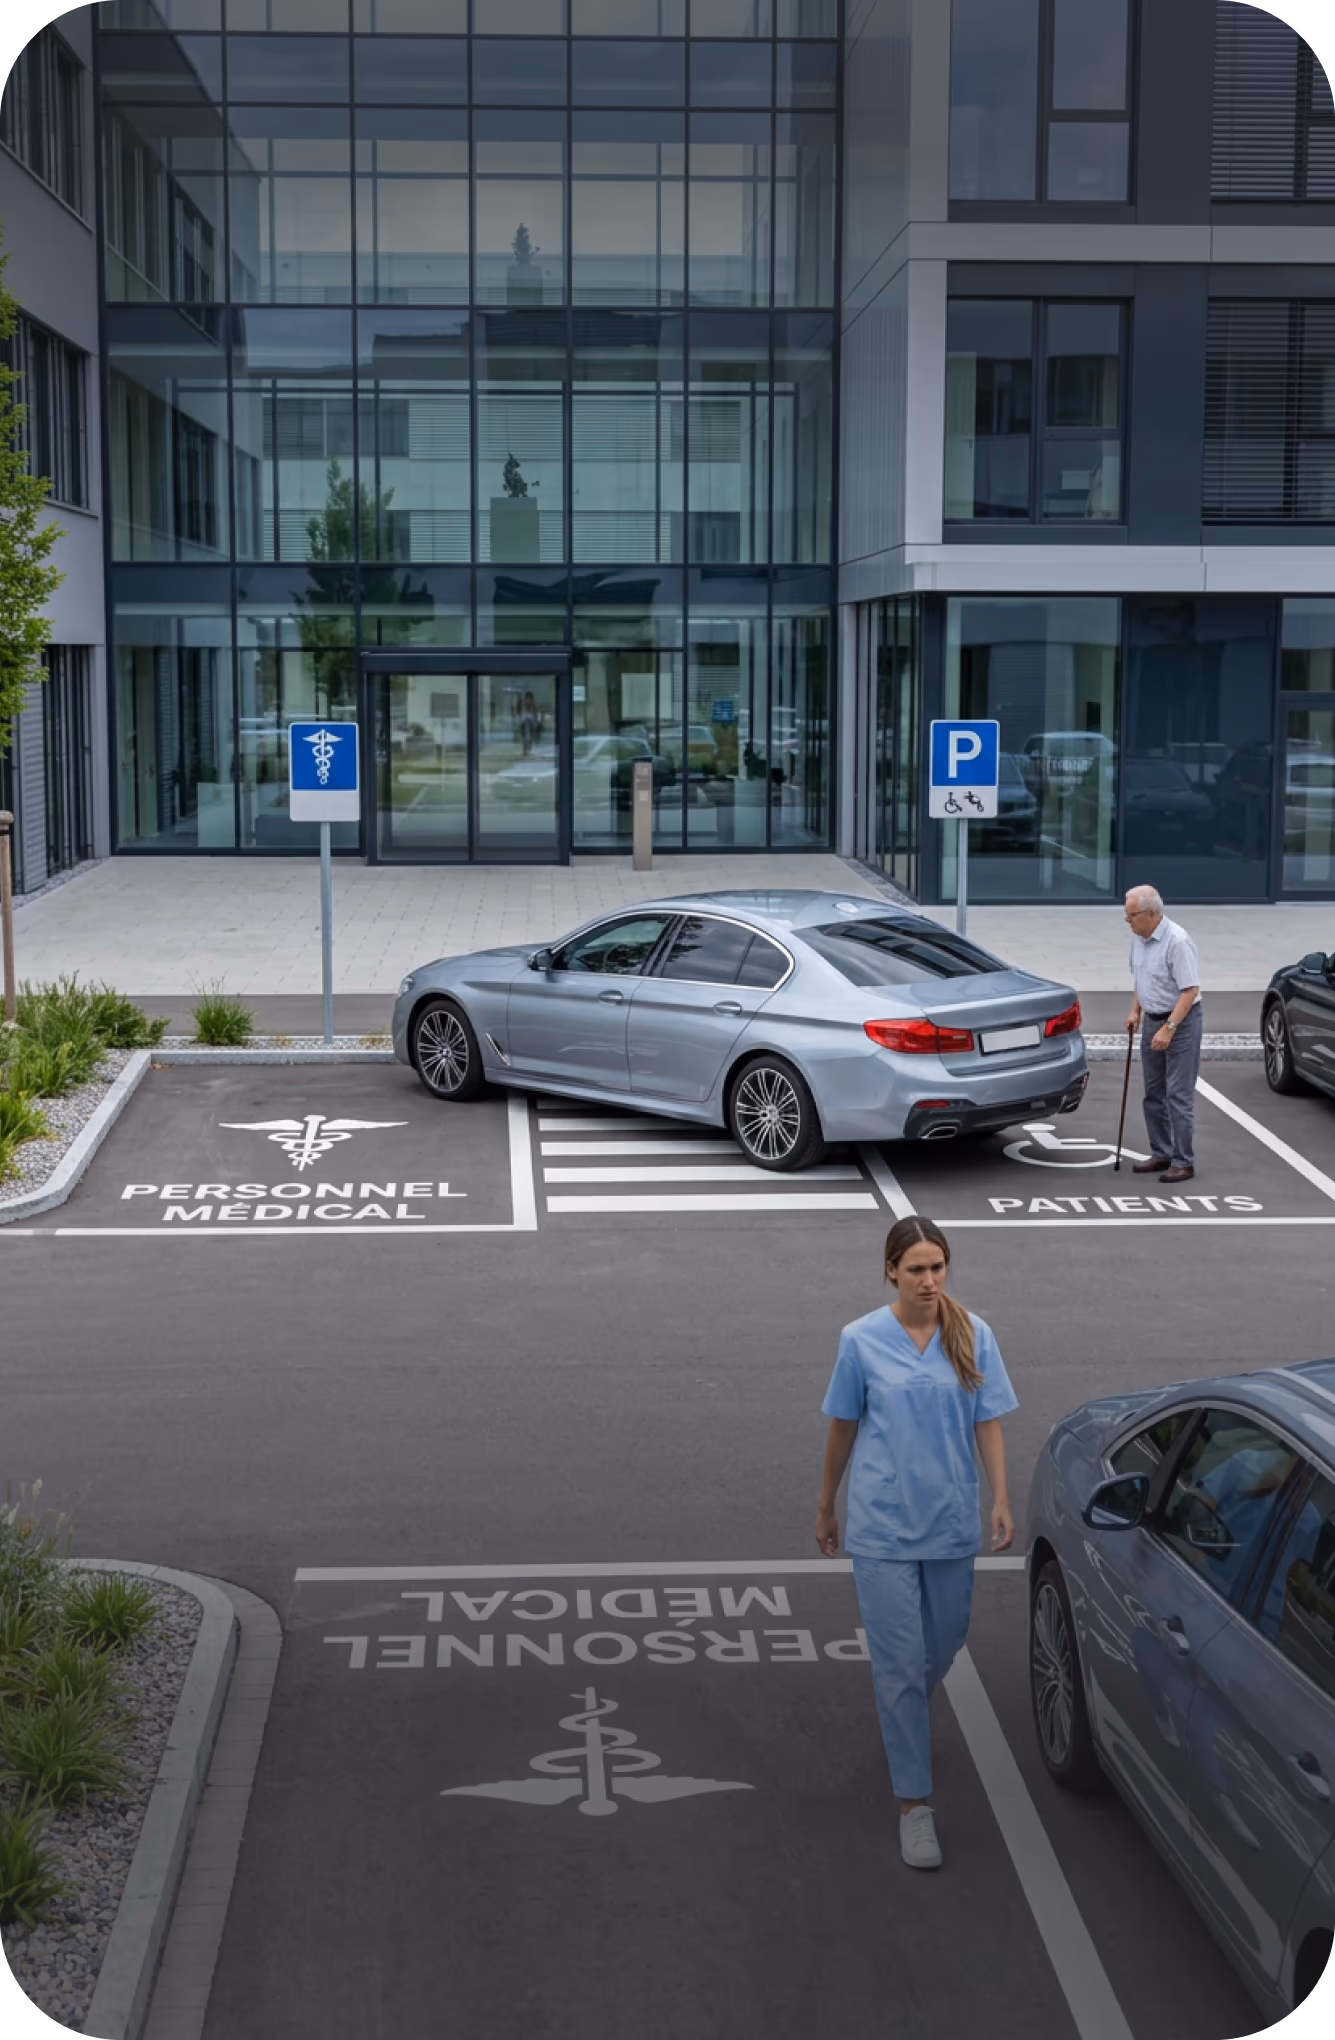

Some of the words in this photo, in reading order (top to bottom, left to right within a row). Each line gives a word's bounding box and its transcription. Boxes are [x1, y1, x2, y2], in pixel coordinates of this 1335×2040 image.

[948, 730, 982, 778] P
[119, 1181, 468, 1200] PERSONNEL
[987, 1195, 1264, 1213] PATIENTS
[161, 1200, 427, 1222] MÉDICAL
[400, 1585, 792, 1628] MÉDICAL
[322, 1627, 871, 1670] PERSONNEL
